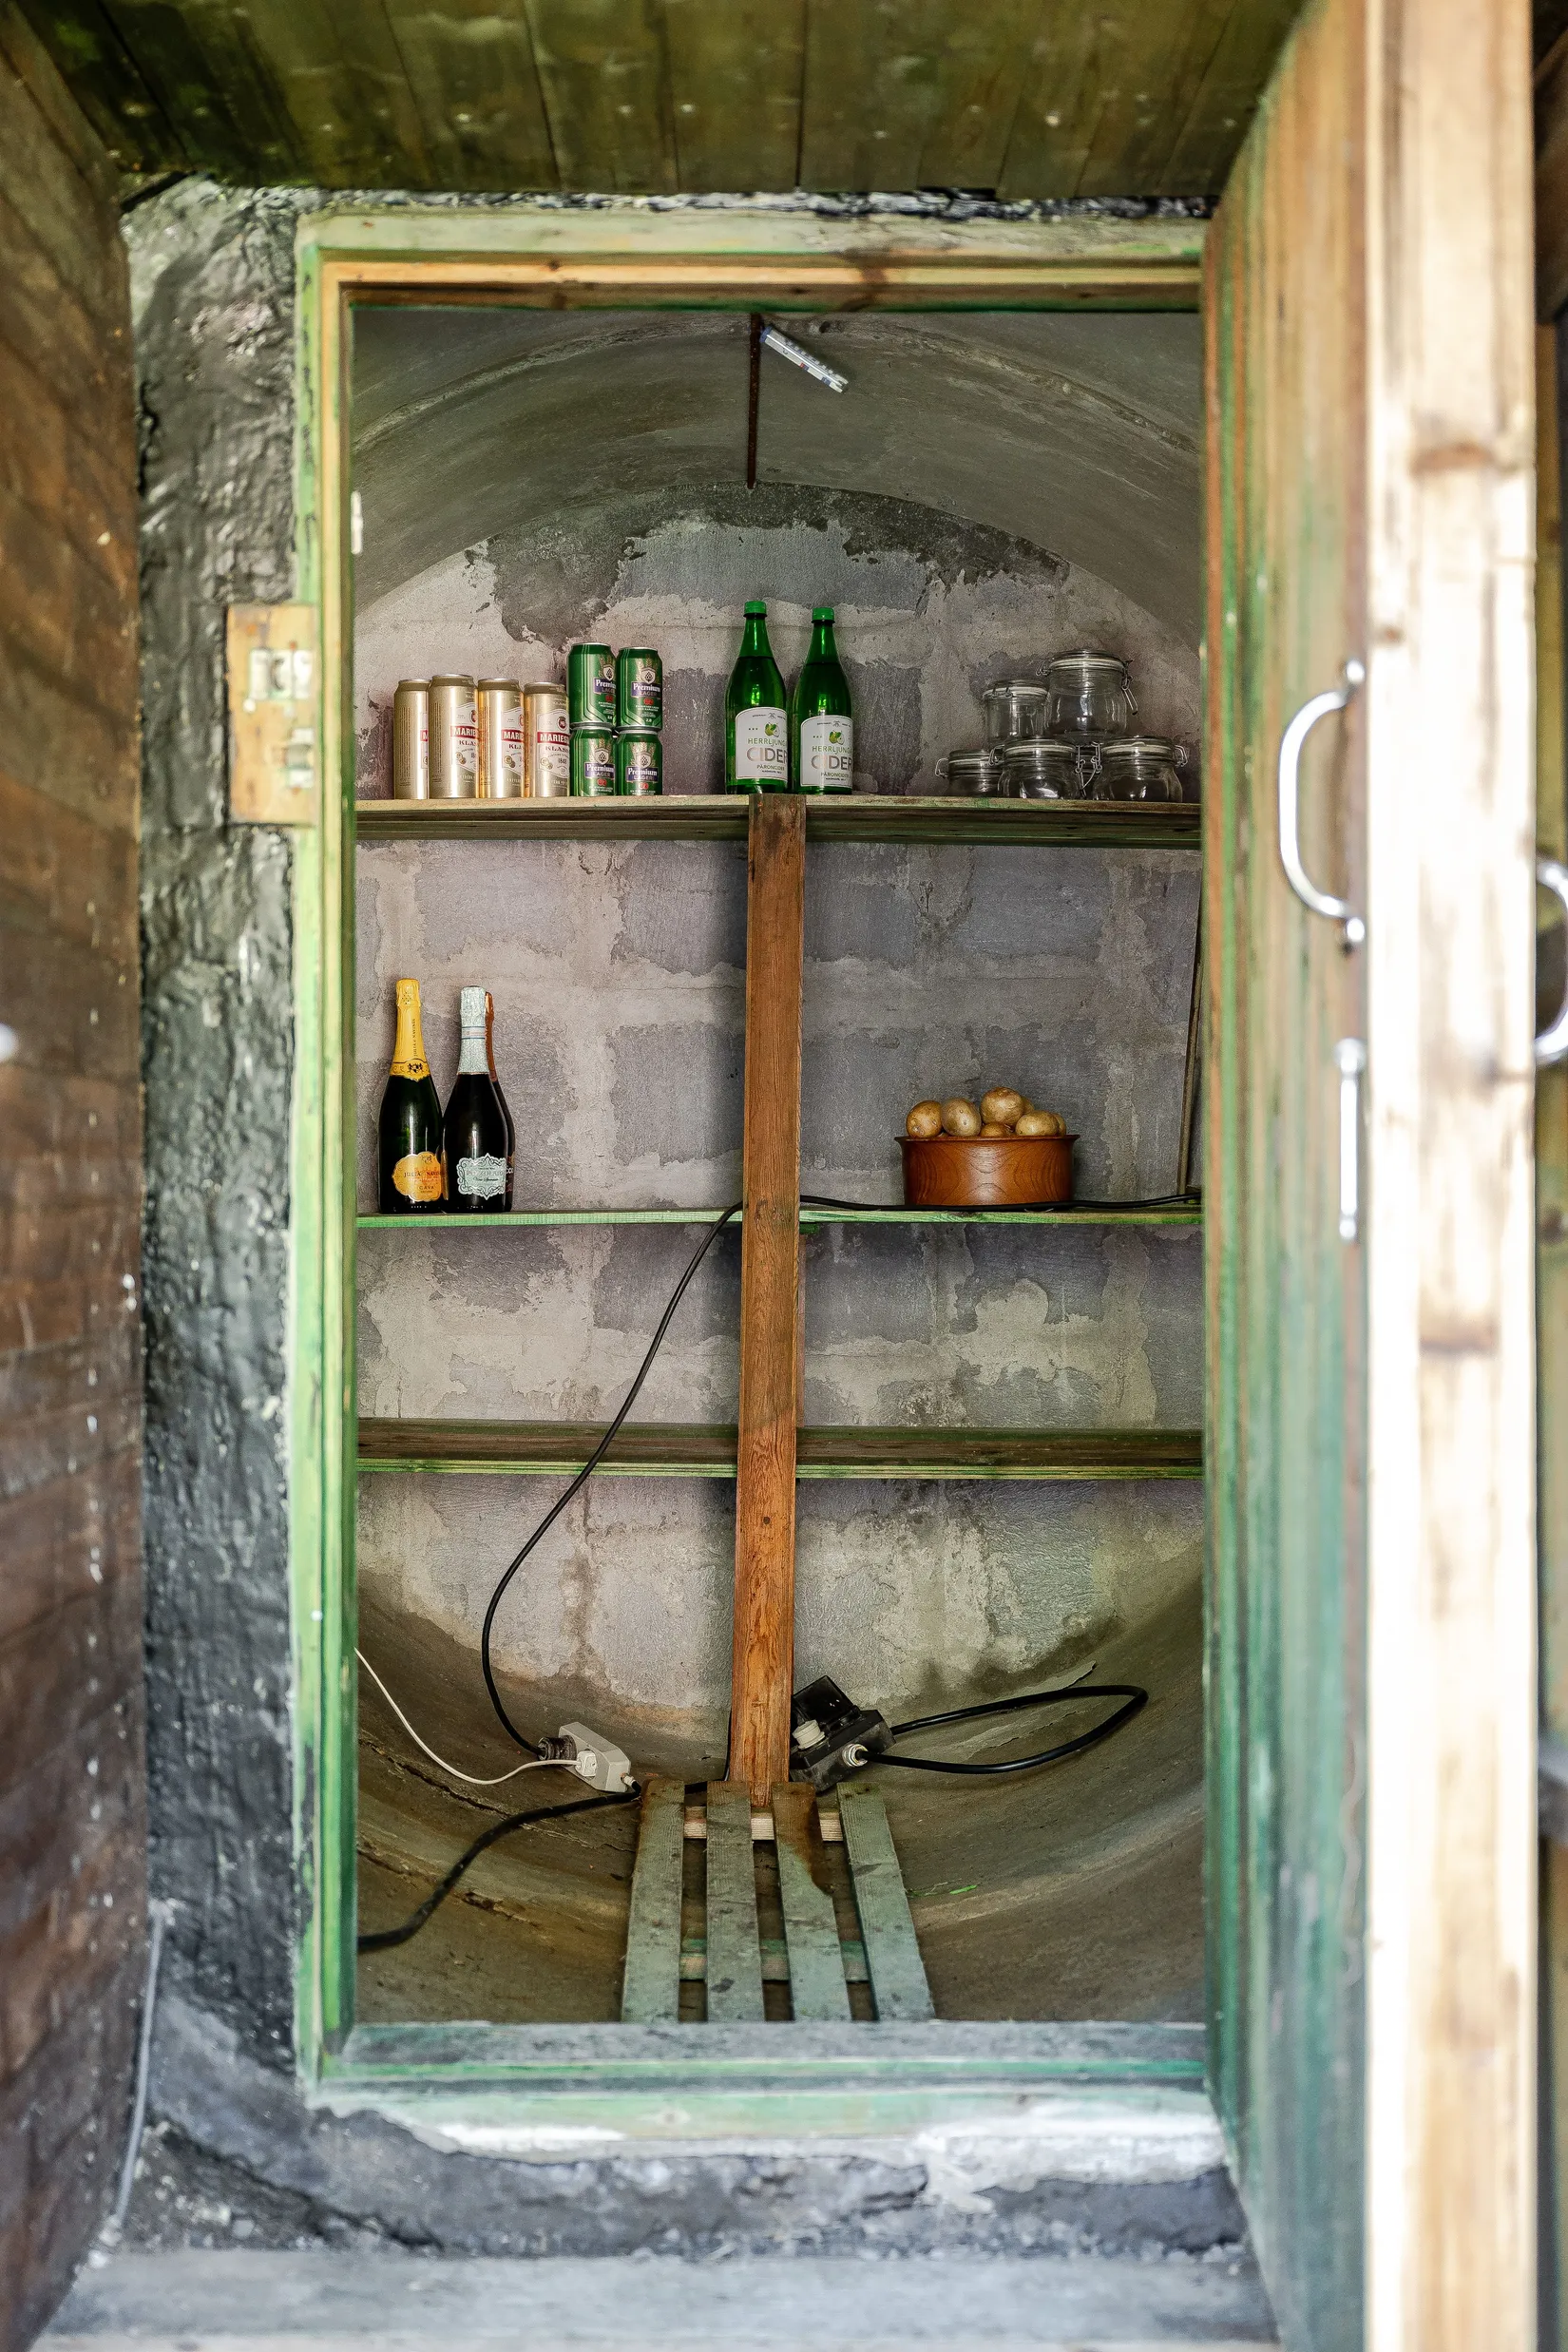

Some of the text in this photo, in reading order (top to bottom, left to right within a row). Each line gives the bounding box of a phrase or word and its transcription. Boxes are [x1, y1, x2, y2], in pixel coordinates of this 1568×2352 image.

[633, 683, 660, 692] Premium
[586, 764, 614, 773] Premium
[628, 767, 658, 776] Premium
